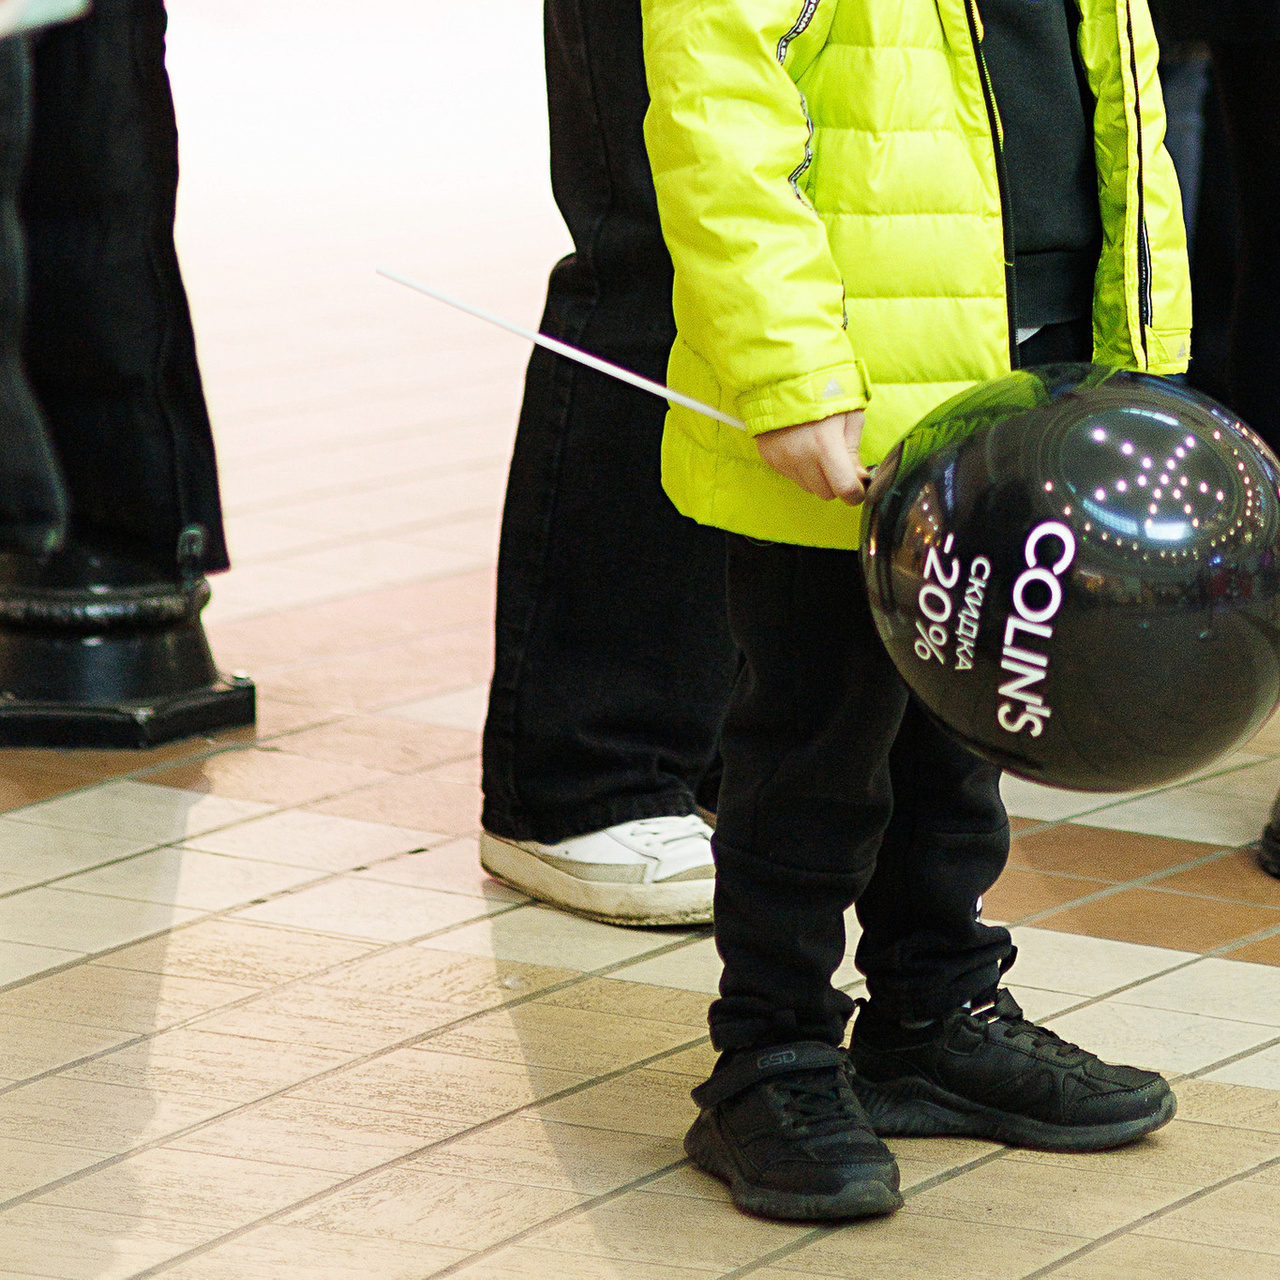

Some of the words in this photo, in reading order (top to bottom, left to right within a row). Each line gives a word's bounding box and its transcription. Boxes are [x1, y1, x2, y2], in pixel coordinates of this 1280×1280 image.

[913, 532, 961, 666] -20%
[954, 555, 992, 672] СКИДКА
[997, 520, 1077, 738] COLIN'S
